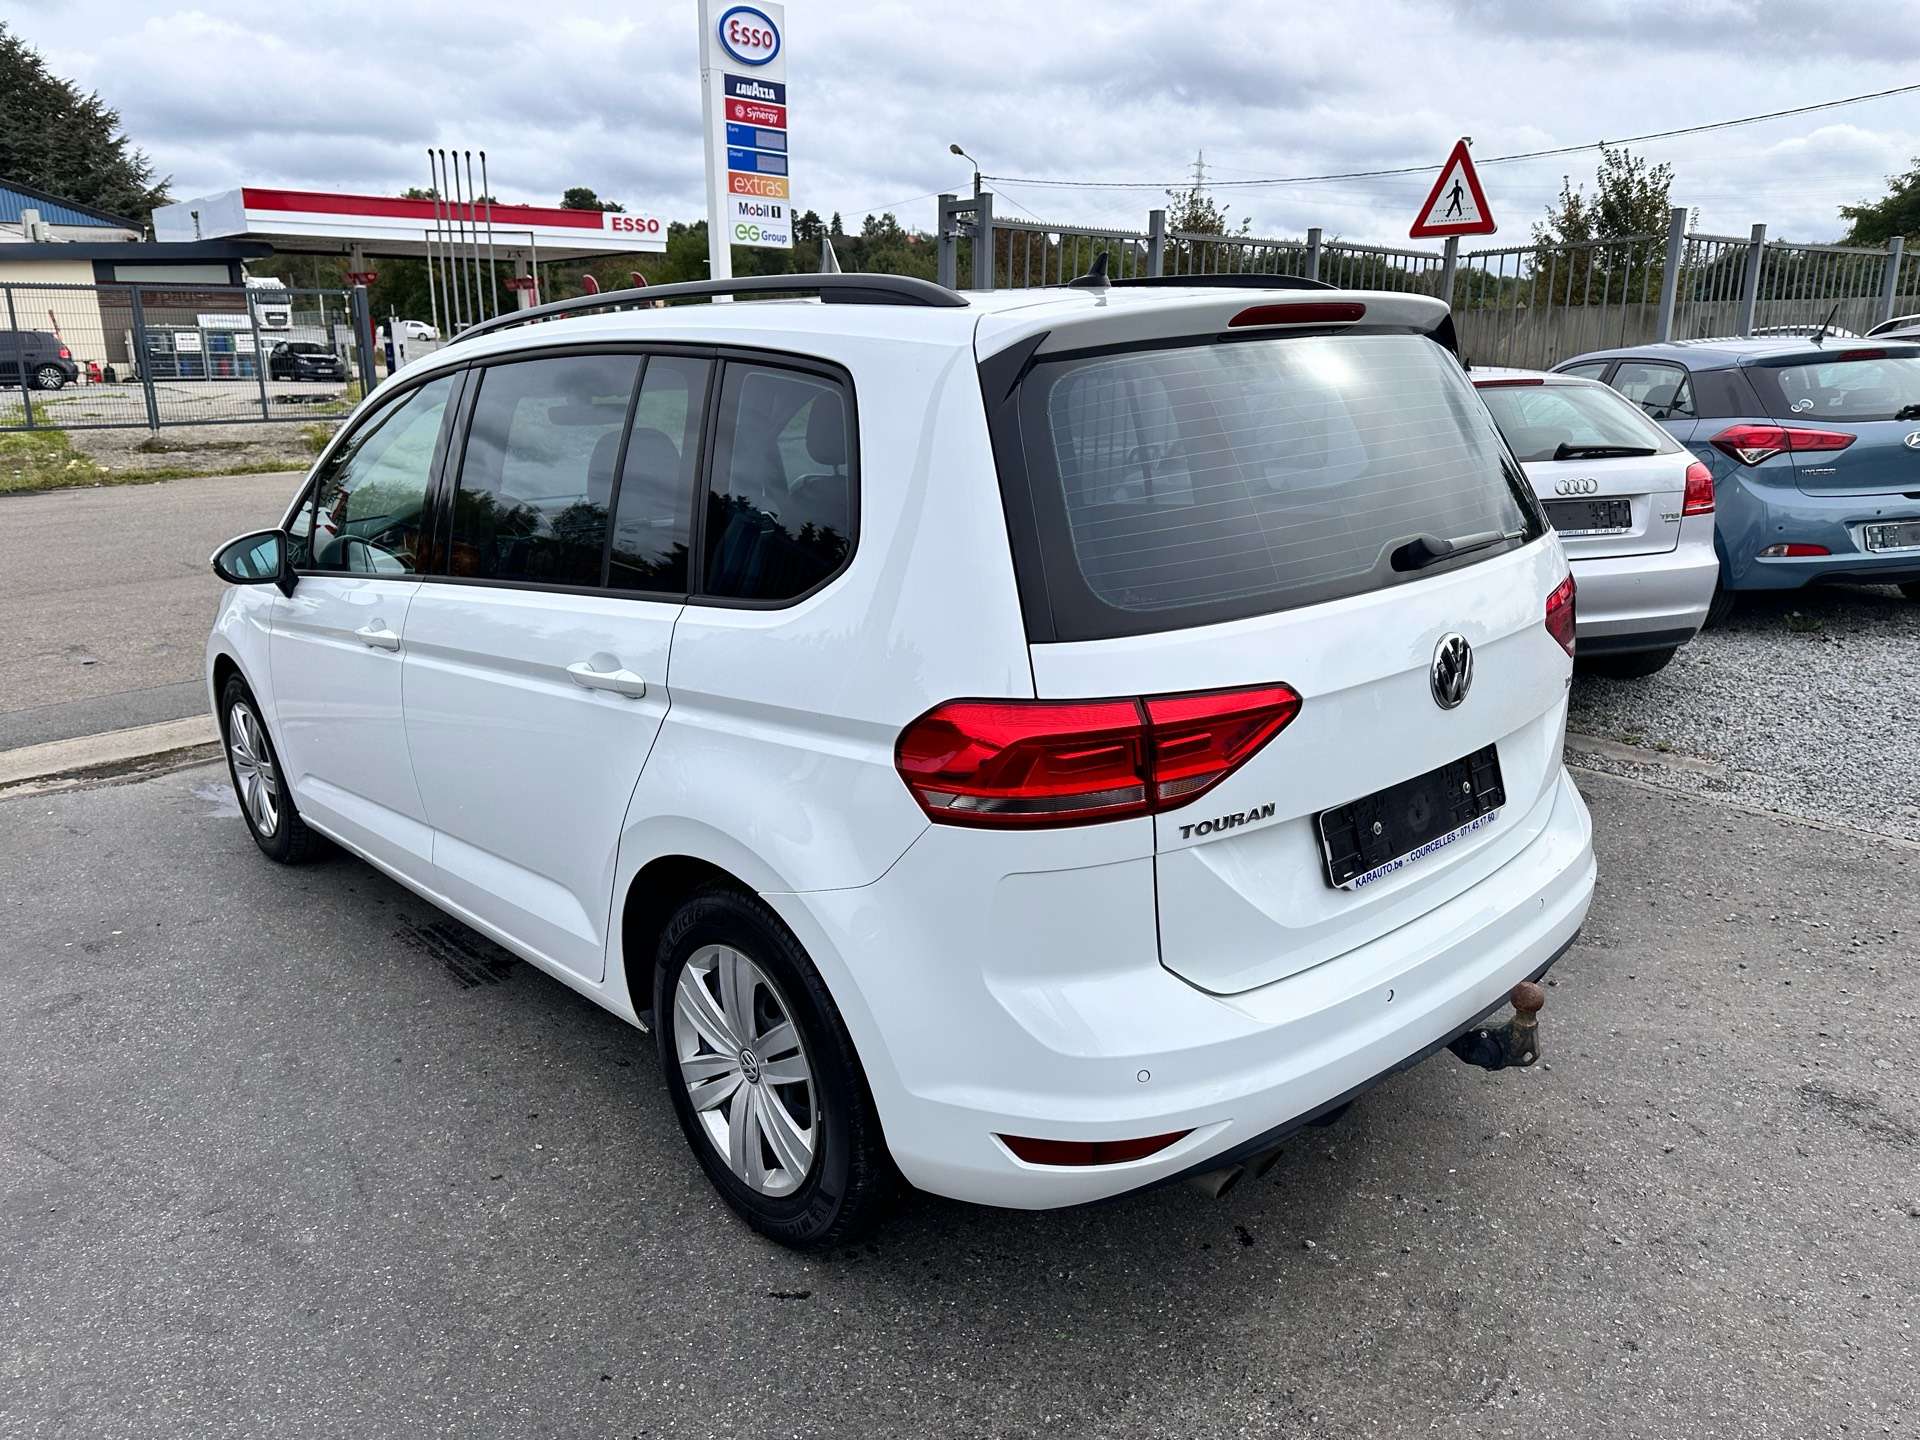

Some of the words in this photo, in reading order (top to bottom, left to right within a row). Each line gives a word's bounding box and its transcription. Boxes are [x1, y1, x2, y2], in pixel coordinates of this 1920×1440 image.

[735, 81, 776, 101] LAVAZZA
[746, 107, 778, 124] Synergy
[734, 176, 784, 197] extras
[738, 201, 769, 218] Mobil
[611, 216, 660, 234] ESSO
[761, 230, 788, 245] Group
[1179, 801, 1276, 840] TOURAN
[1355, 859, 1403, 889] KARAUTO.be
[1410, 832, 1456, 862] COURCELLES
